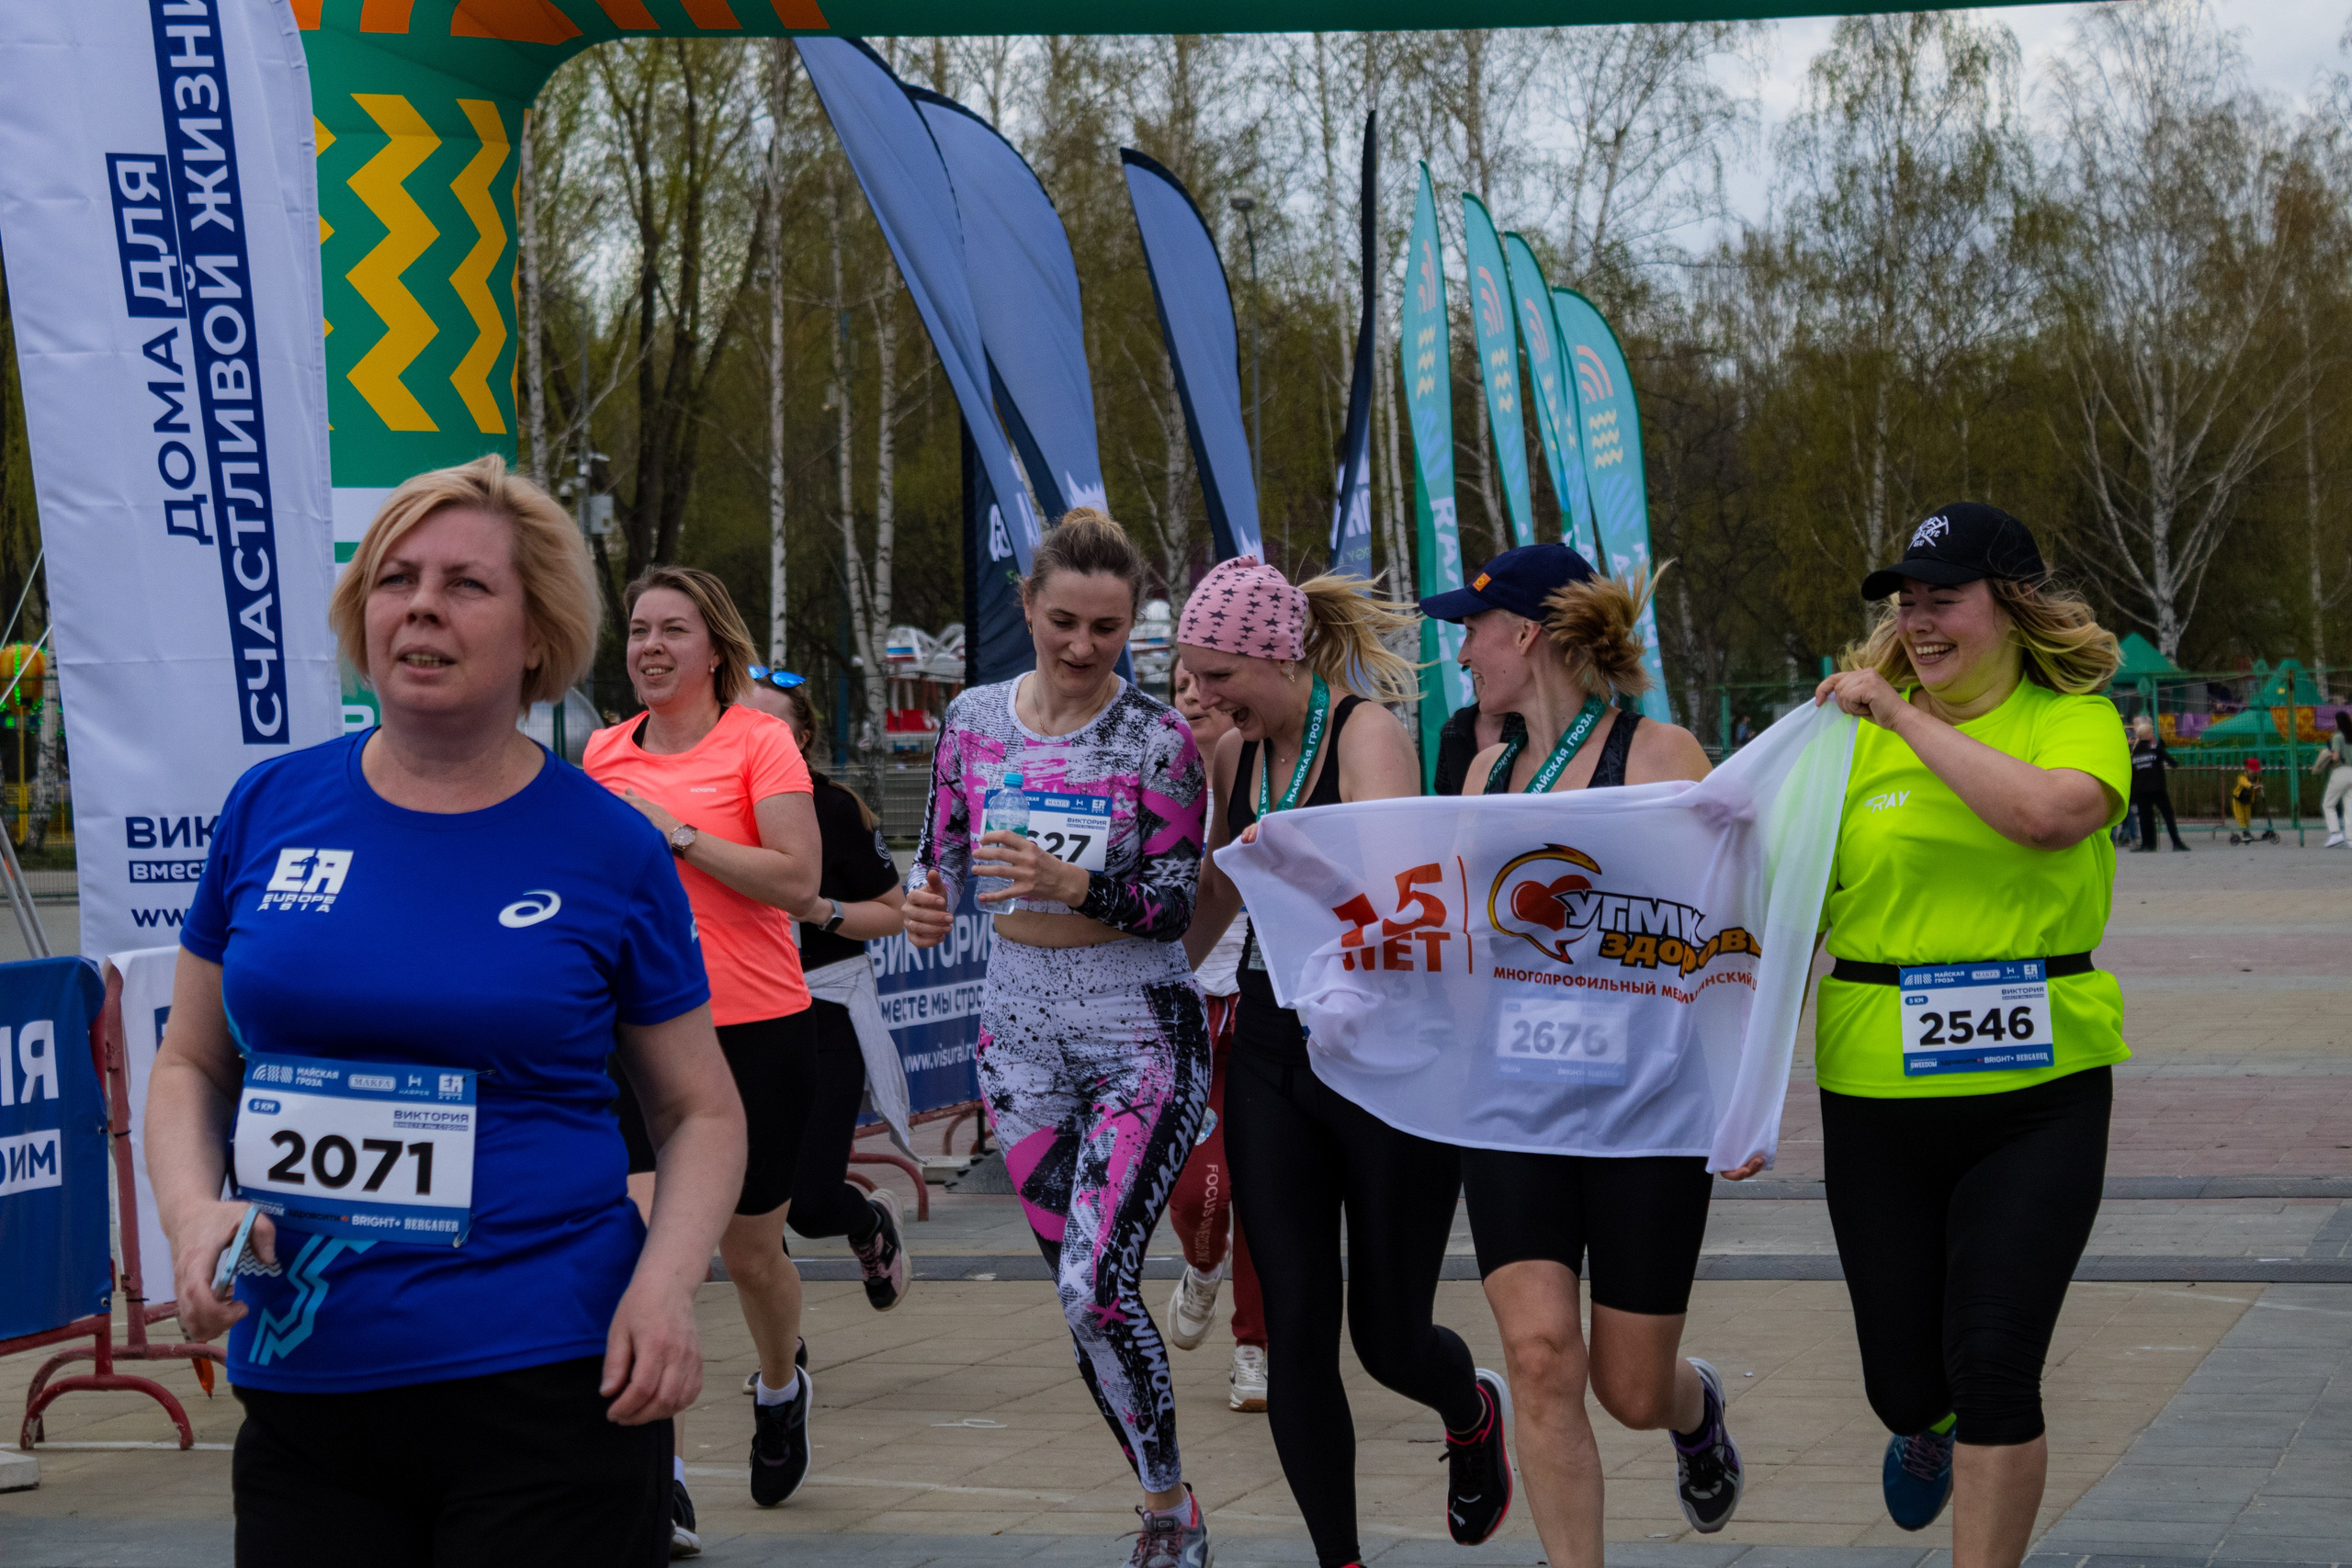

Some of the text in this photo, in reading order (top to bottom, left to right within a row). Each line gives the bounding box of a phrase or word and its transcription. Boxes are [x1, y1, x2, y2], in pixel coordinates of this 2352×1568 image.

[116, 160, 214, 546] ДОМА ДЛЯ
[185, 254, 282, 737] СЧАСТЛИВОЙ
[1566, 713, 1595, 747] ГРОЗА
[1286, 750, 1313, 803] МАЙСКАЯ
[1307, 708, 1324, 745] ГРОЗА
[1067, 818, 1107, 826] ВИКТОРИЯ
[256, 903, 331, 913] ASIA
[262, 893, 337, 905] EUROPE
[130, 908, 191, 928] ww
[1494, 966, 1656, 996] МНОГОПРОФИЛЬНЫЙ
[2001, 987, 2045, 996] ВИКТОРИЯ
[881, 994, 928, 1023] месте
[932, 993, 952, 1016] мы
[1511, 1020, 1608, 1056] 2676
[1918, 1006, 2035, 1046] 2546
[295, 1077, 323, 1088] ГРОЗА
[296, 1066, 340, 1080] МАЙСКАЯ
[354, 1077, 392, 1089] MAKFA
[253, 1102, 260, 1111] 5
[393, 1110, 469, 1123] ВИКТОРИЯ
[1145, 1056, 1209, 1222] MACHINE
[267, 1129, 435, 1196] 2071
[1203, 1164, 1219, 1219] FOCUS
